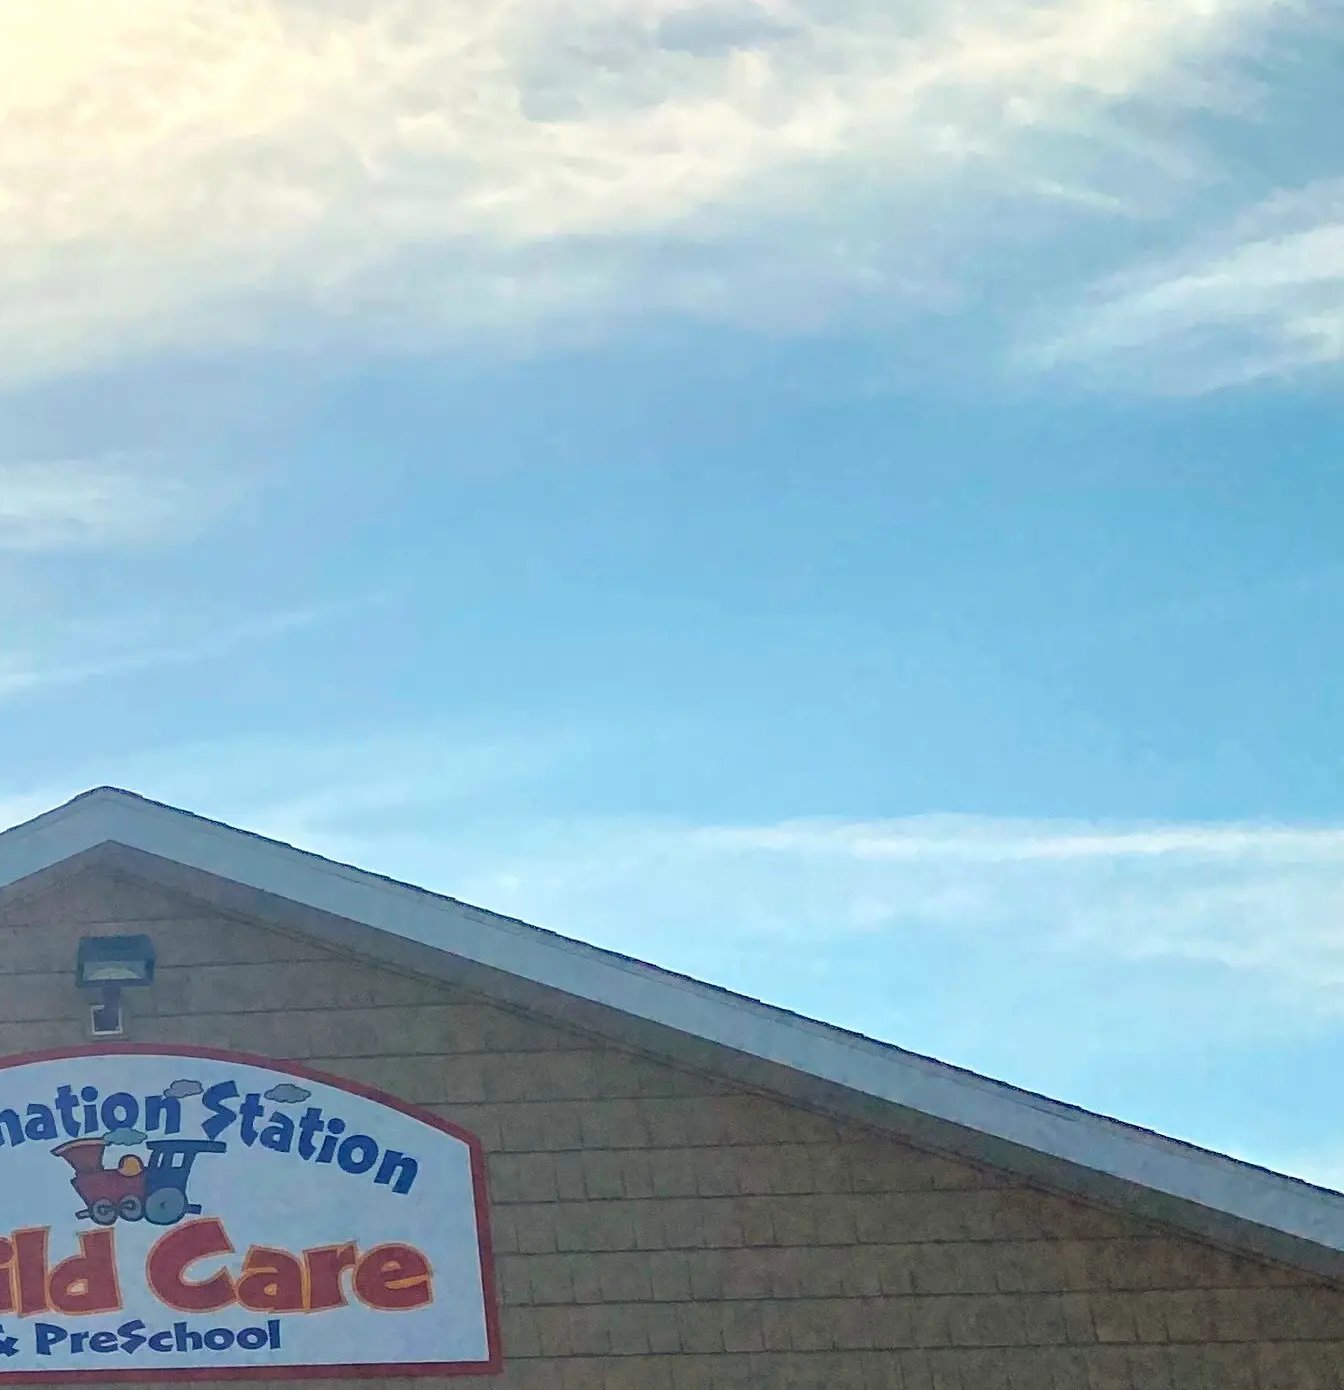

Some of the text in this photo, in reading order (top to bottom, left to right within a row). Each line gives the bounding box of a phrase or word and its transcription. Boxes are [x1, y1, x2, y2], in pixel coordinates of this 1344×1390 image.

[202, 1080, 419, 1195] Station
[146, 1218, 435, 1314] Care
[35, 1319, 281, 1356] PreSchool
